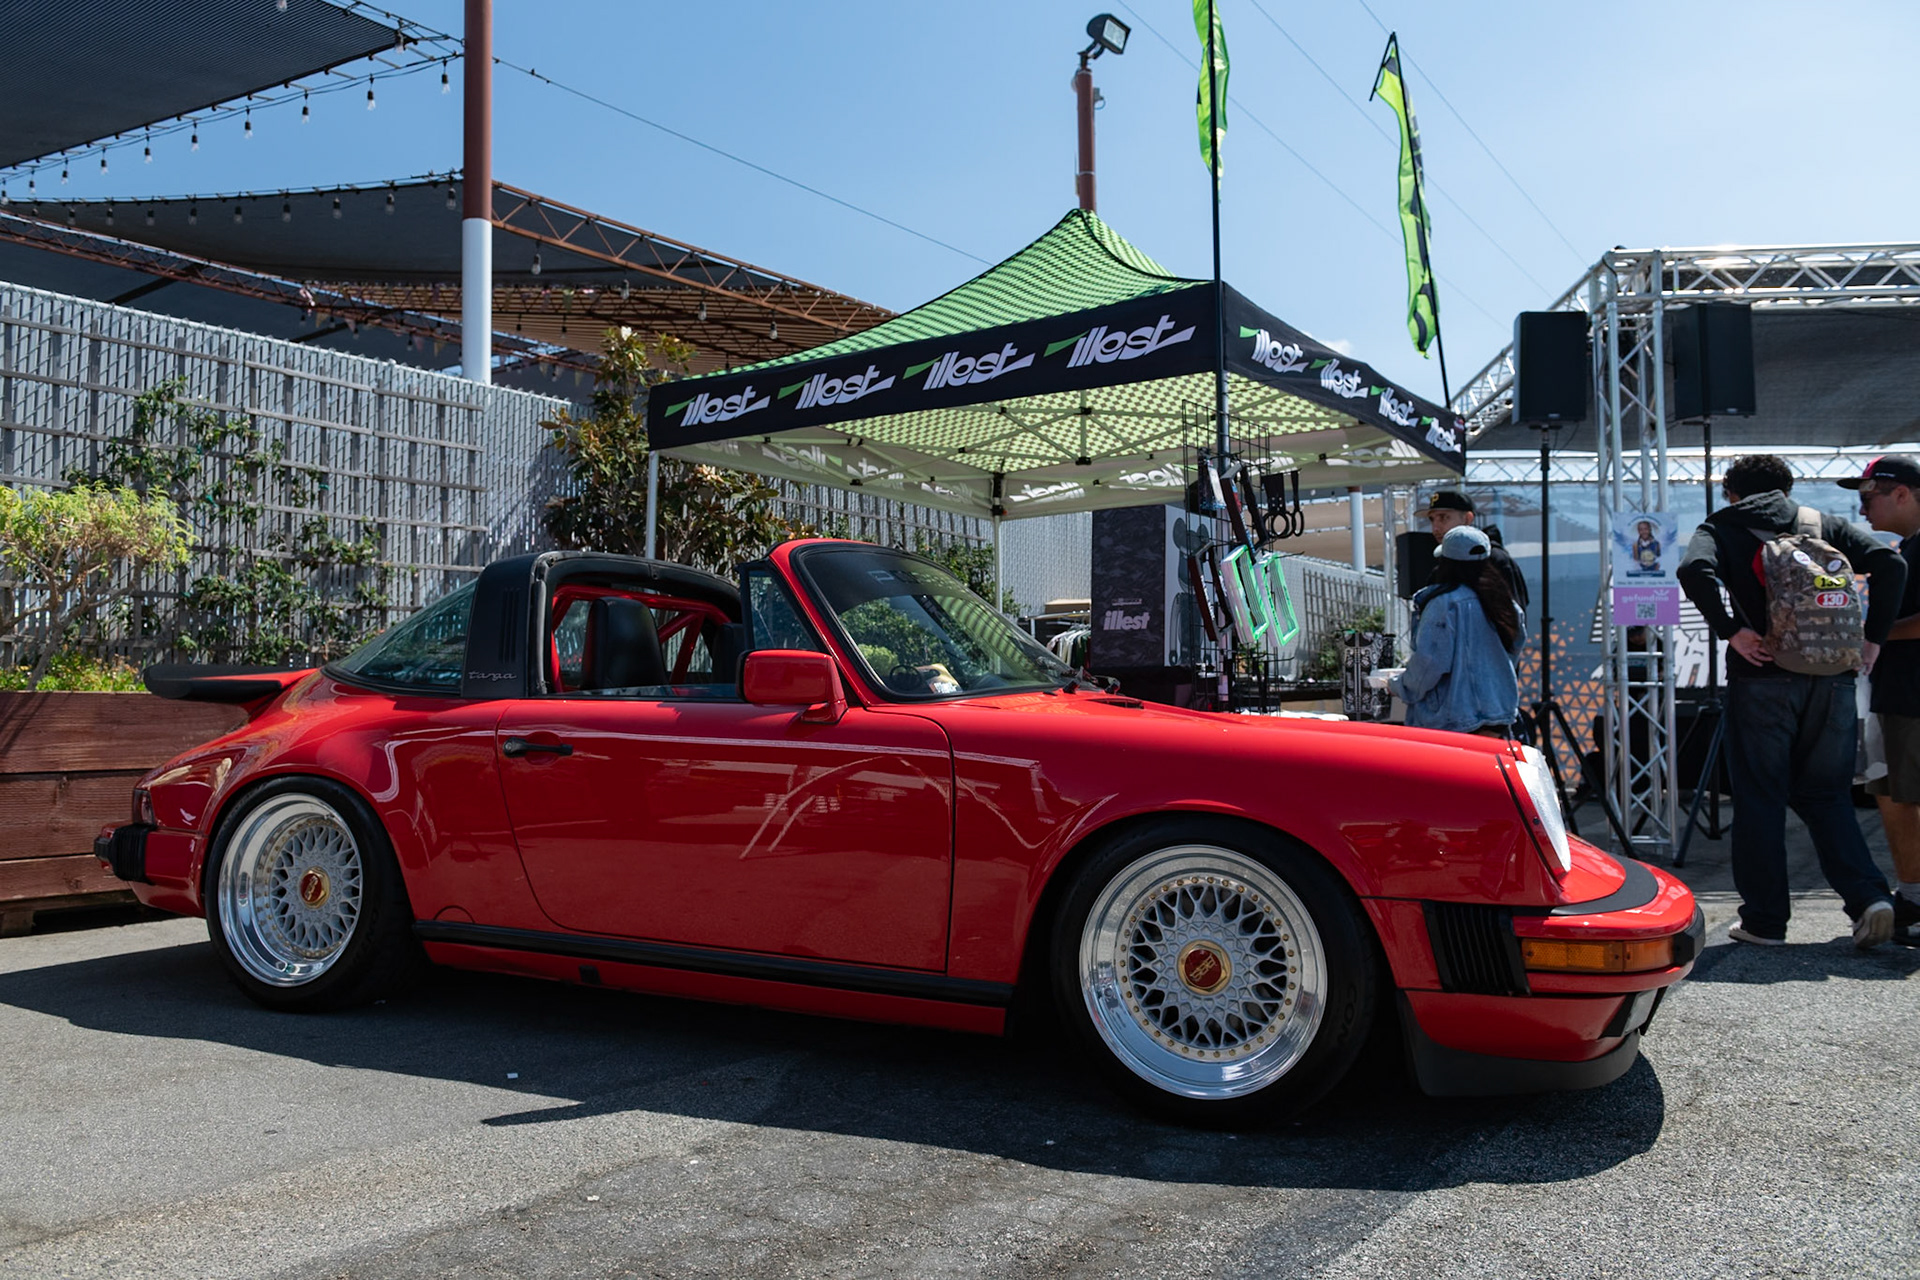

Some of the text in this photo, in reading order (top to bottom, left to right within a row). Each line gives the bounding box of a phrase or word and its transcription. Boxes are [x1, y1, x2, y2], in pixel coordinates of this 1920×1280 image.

[1822, 593, 1845, 606] 130
[1103, 610, 1150, 630] illest
[468, 671, 517, 681] targa
